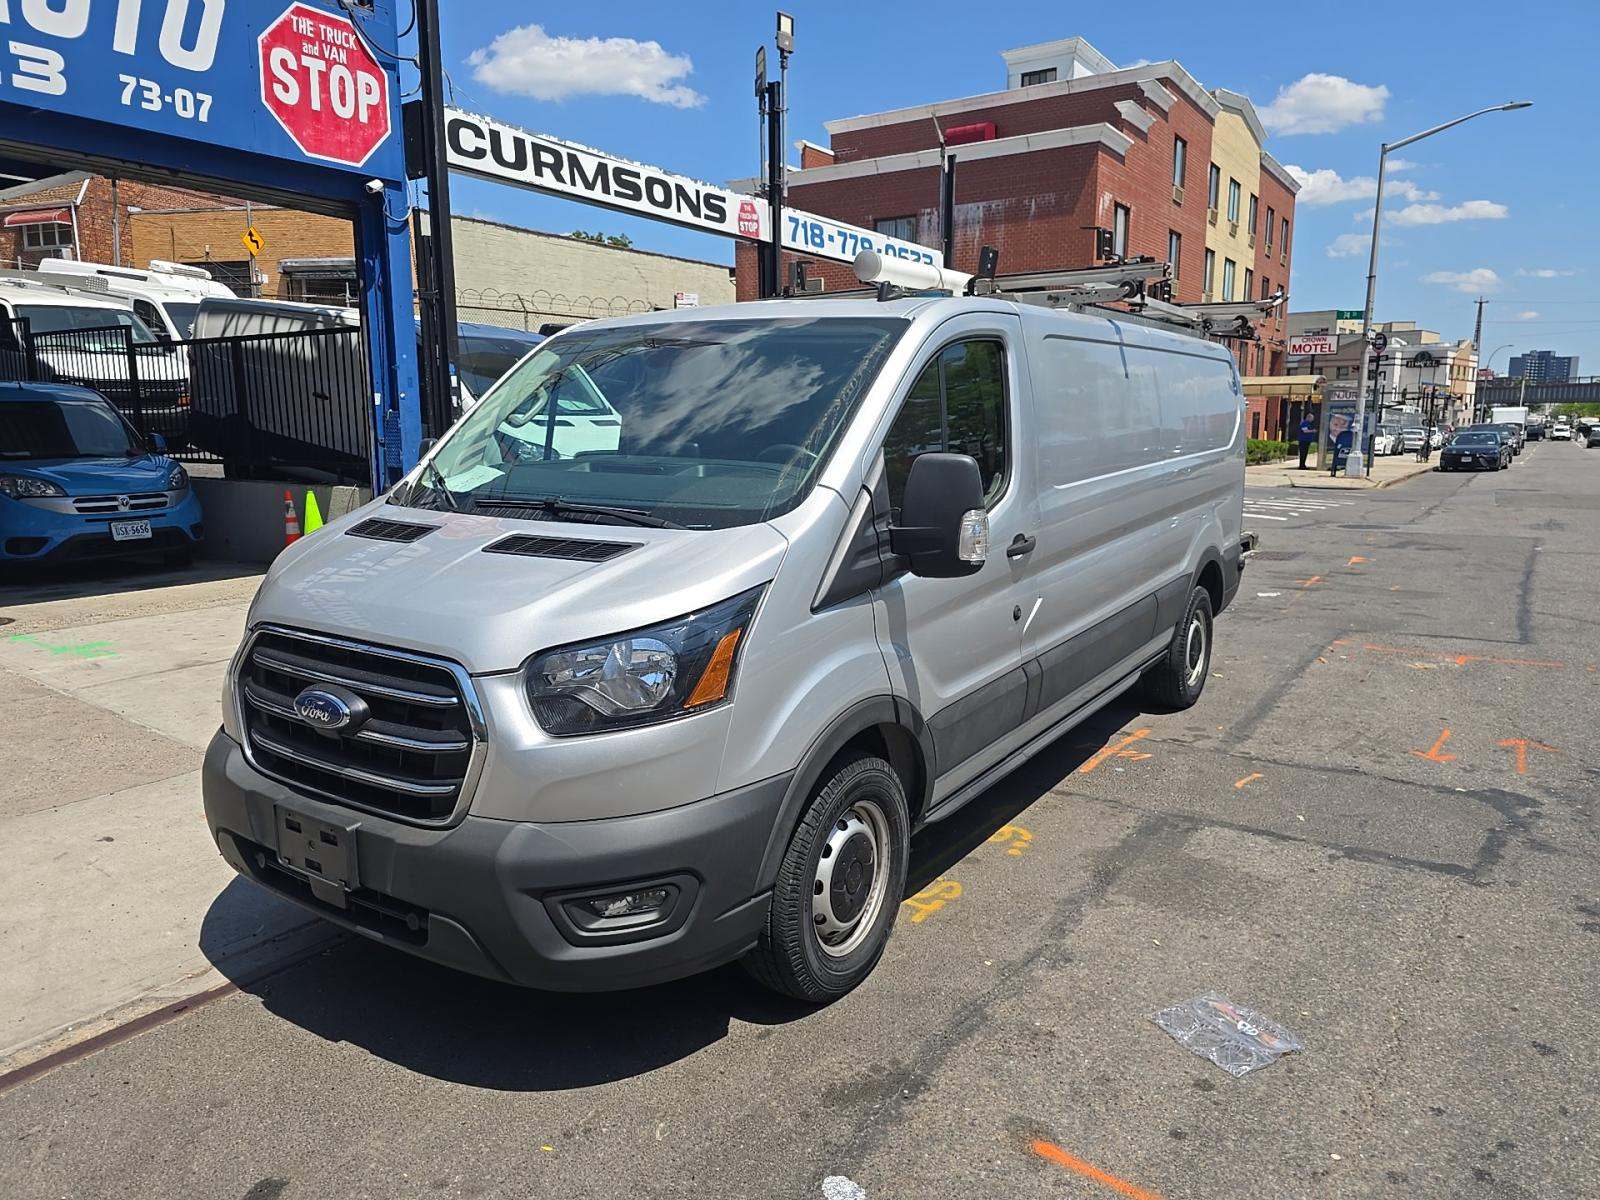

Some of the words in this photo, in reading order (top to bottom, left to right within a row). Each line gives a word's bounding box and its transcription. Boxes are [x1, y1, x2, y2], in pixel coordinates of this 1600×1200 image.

[291, 15, 314, 38] THE
[319, 24, 357, 50] TRUCK
[302, 41, 319, 56] and
[322, 43, 347, 64] VAN
[119, 73, 213, 123] 73-07
[270, 47, 380, 124] STOP
[447, 117, 727, 224] CURMSONS
[740, 220, 758, 232] STOP
[1291, 343, 1335, 353] MOTEL
[302, 698, 332, 722] Ford
